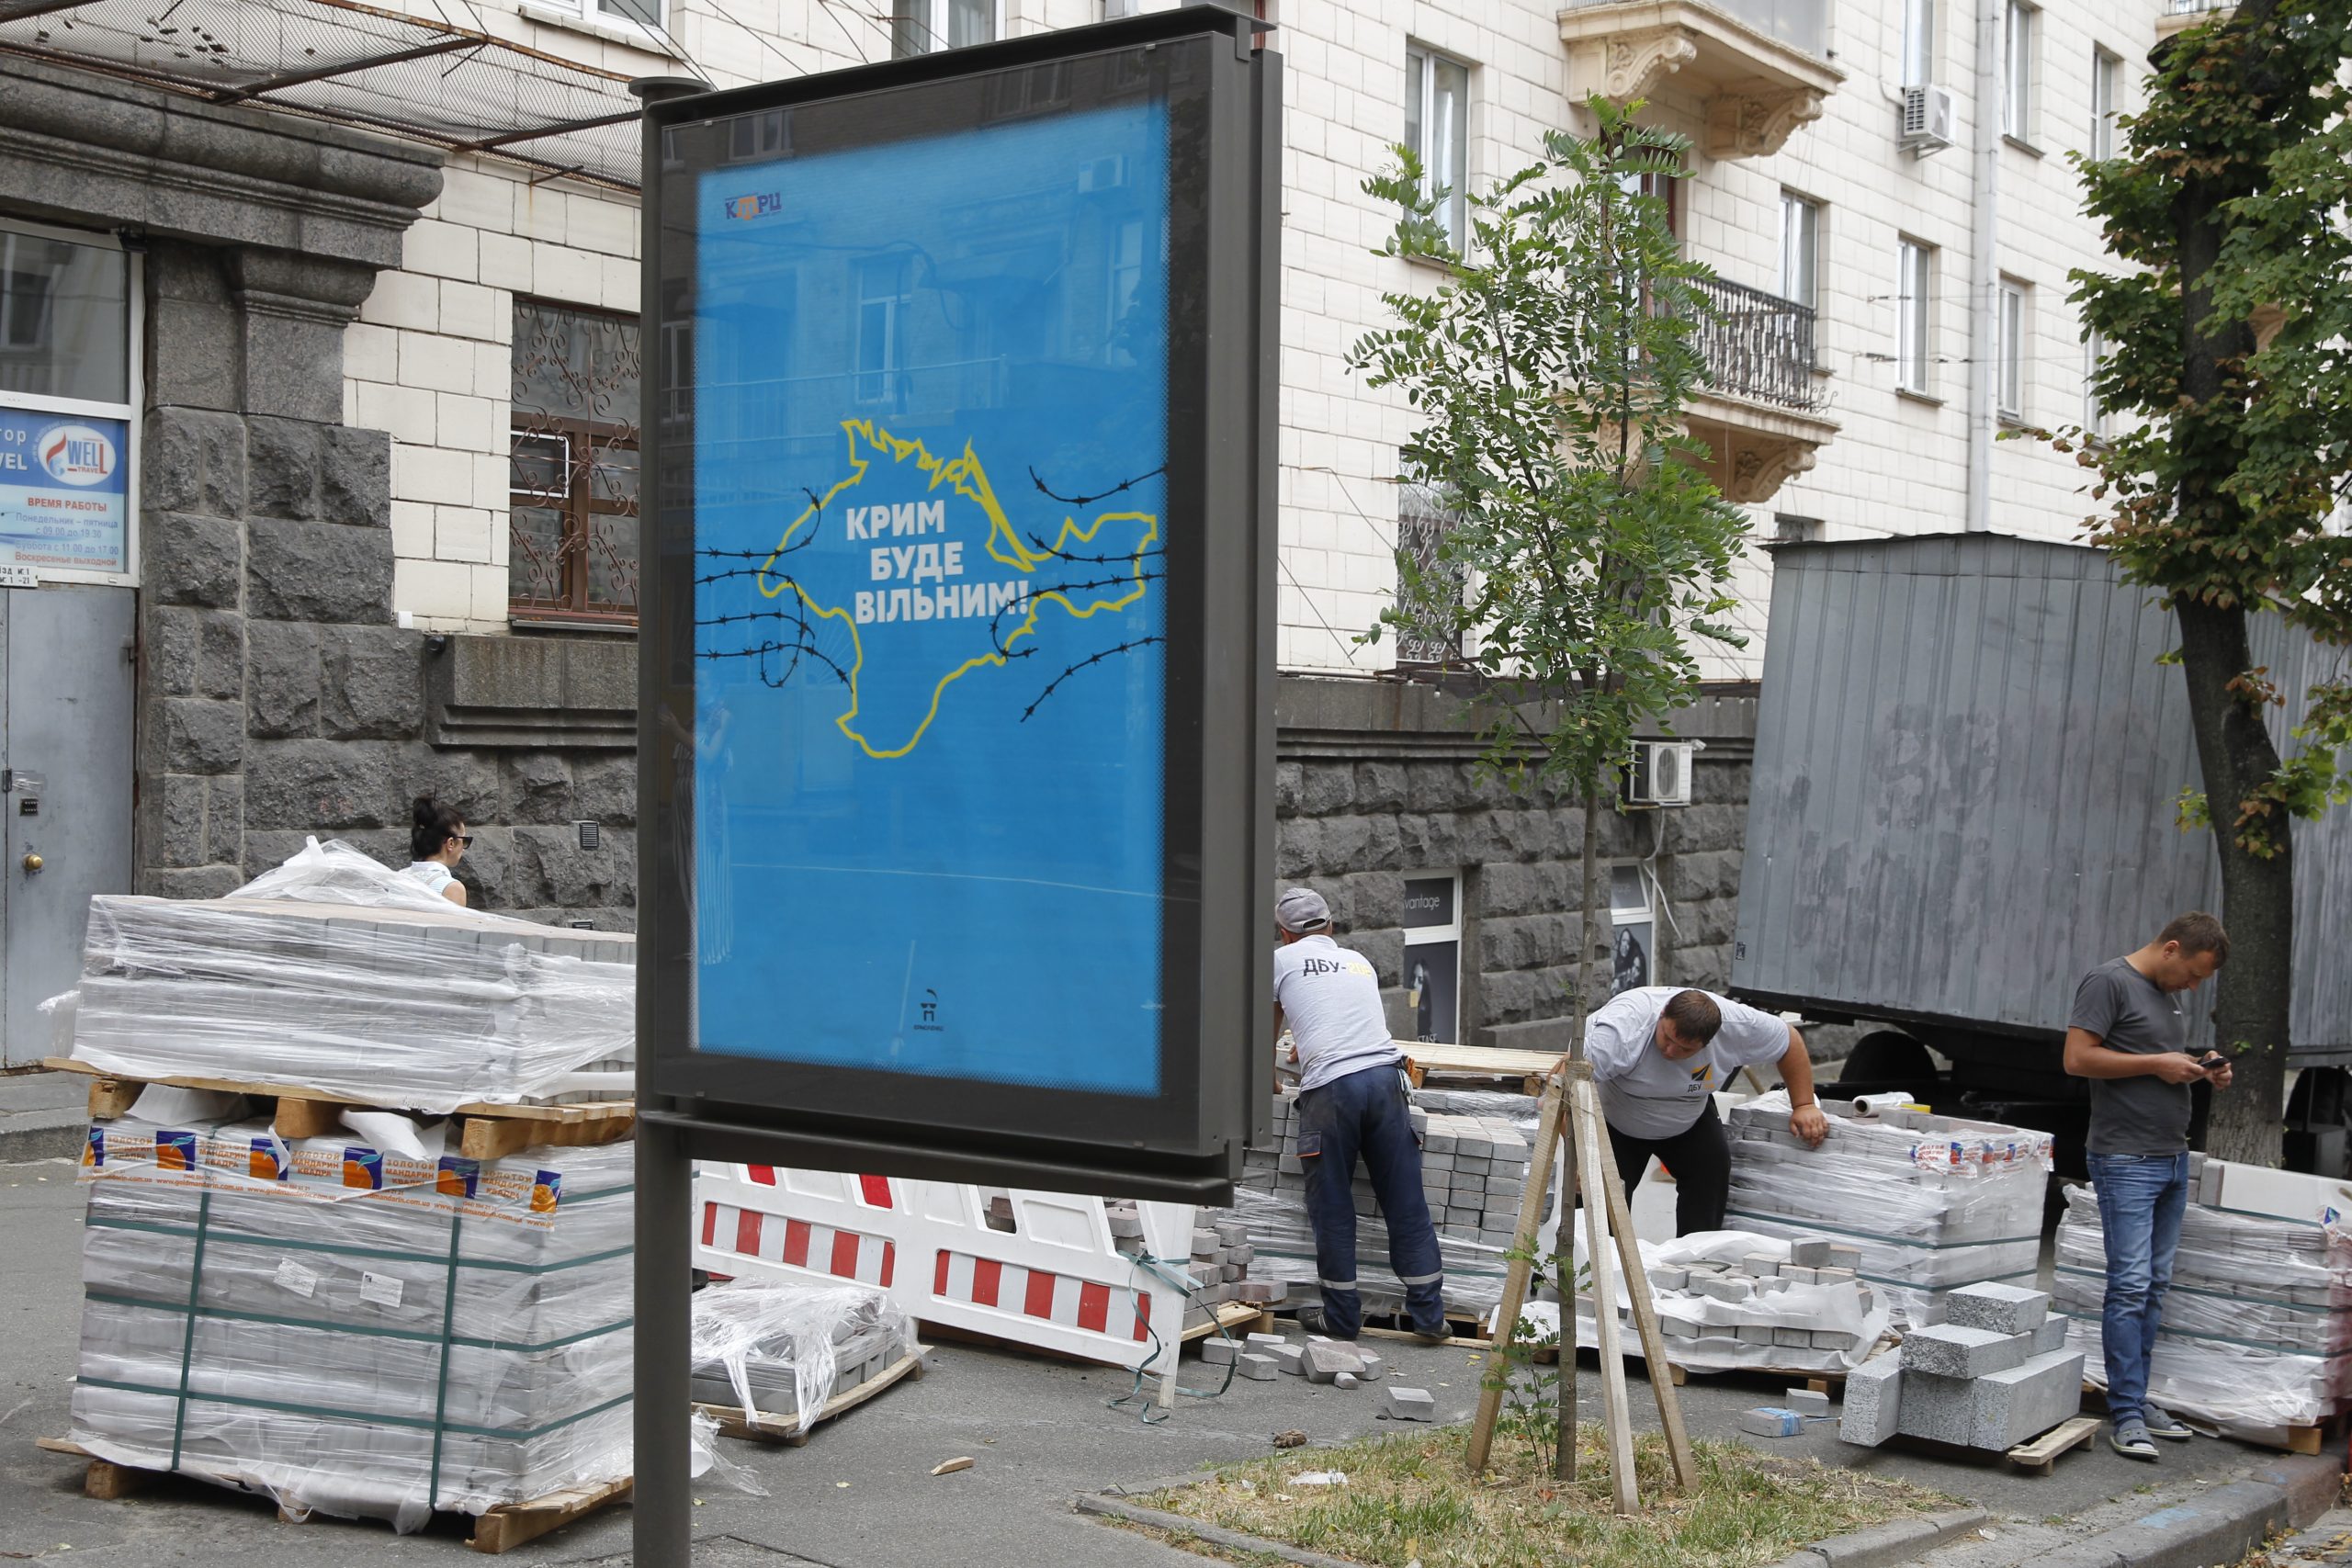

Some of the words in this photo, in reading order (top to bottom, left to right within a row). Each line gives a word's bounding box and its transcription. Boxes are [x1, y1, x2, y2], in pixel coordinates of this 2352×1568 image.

[0, 428, 27, 446] ор
[28, 497, 62, 509] ВРЕМЯ
[65, 500, 107, 512] РАБОТЫ
[16, 512, 74, 525] Понедельник
[84, 519, 119, 529] пятница
[846, 500, 945, 540] КРИМ
[15, 551, 72, 563] Воскресенье
[74, 557, 118, 567] выходной
[870, 541, 964, 585] БУДЕ
[855, 580, 1029, 625] ВІЛЬНИМ!
[198, 1147, 247, 1160] МАНДАРИН
[292, 1149, 341, 1161] ЗОЛОТОЙ
[205, 1158, 239, 1168] КВАДРА
[291, 1158, 339, 1170] МАНДАРИН
[387, 1159, 435, 1171] ЗОЛОТОЙ
[297, 1168, 332, 1178] КВАДРА
[385, 1168, 435, 1180] МАНДАРИН
[156, 1178, 244, 1192] www.goldmandarin.com.ua
[481, 1177, 530, 1193] МАНДАРИН
